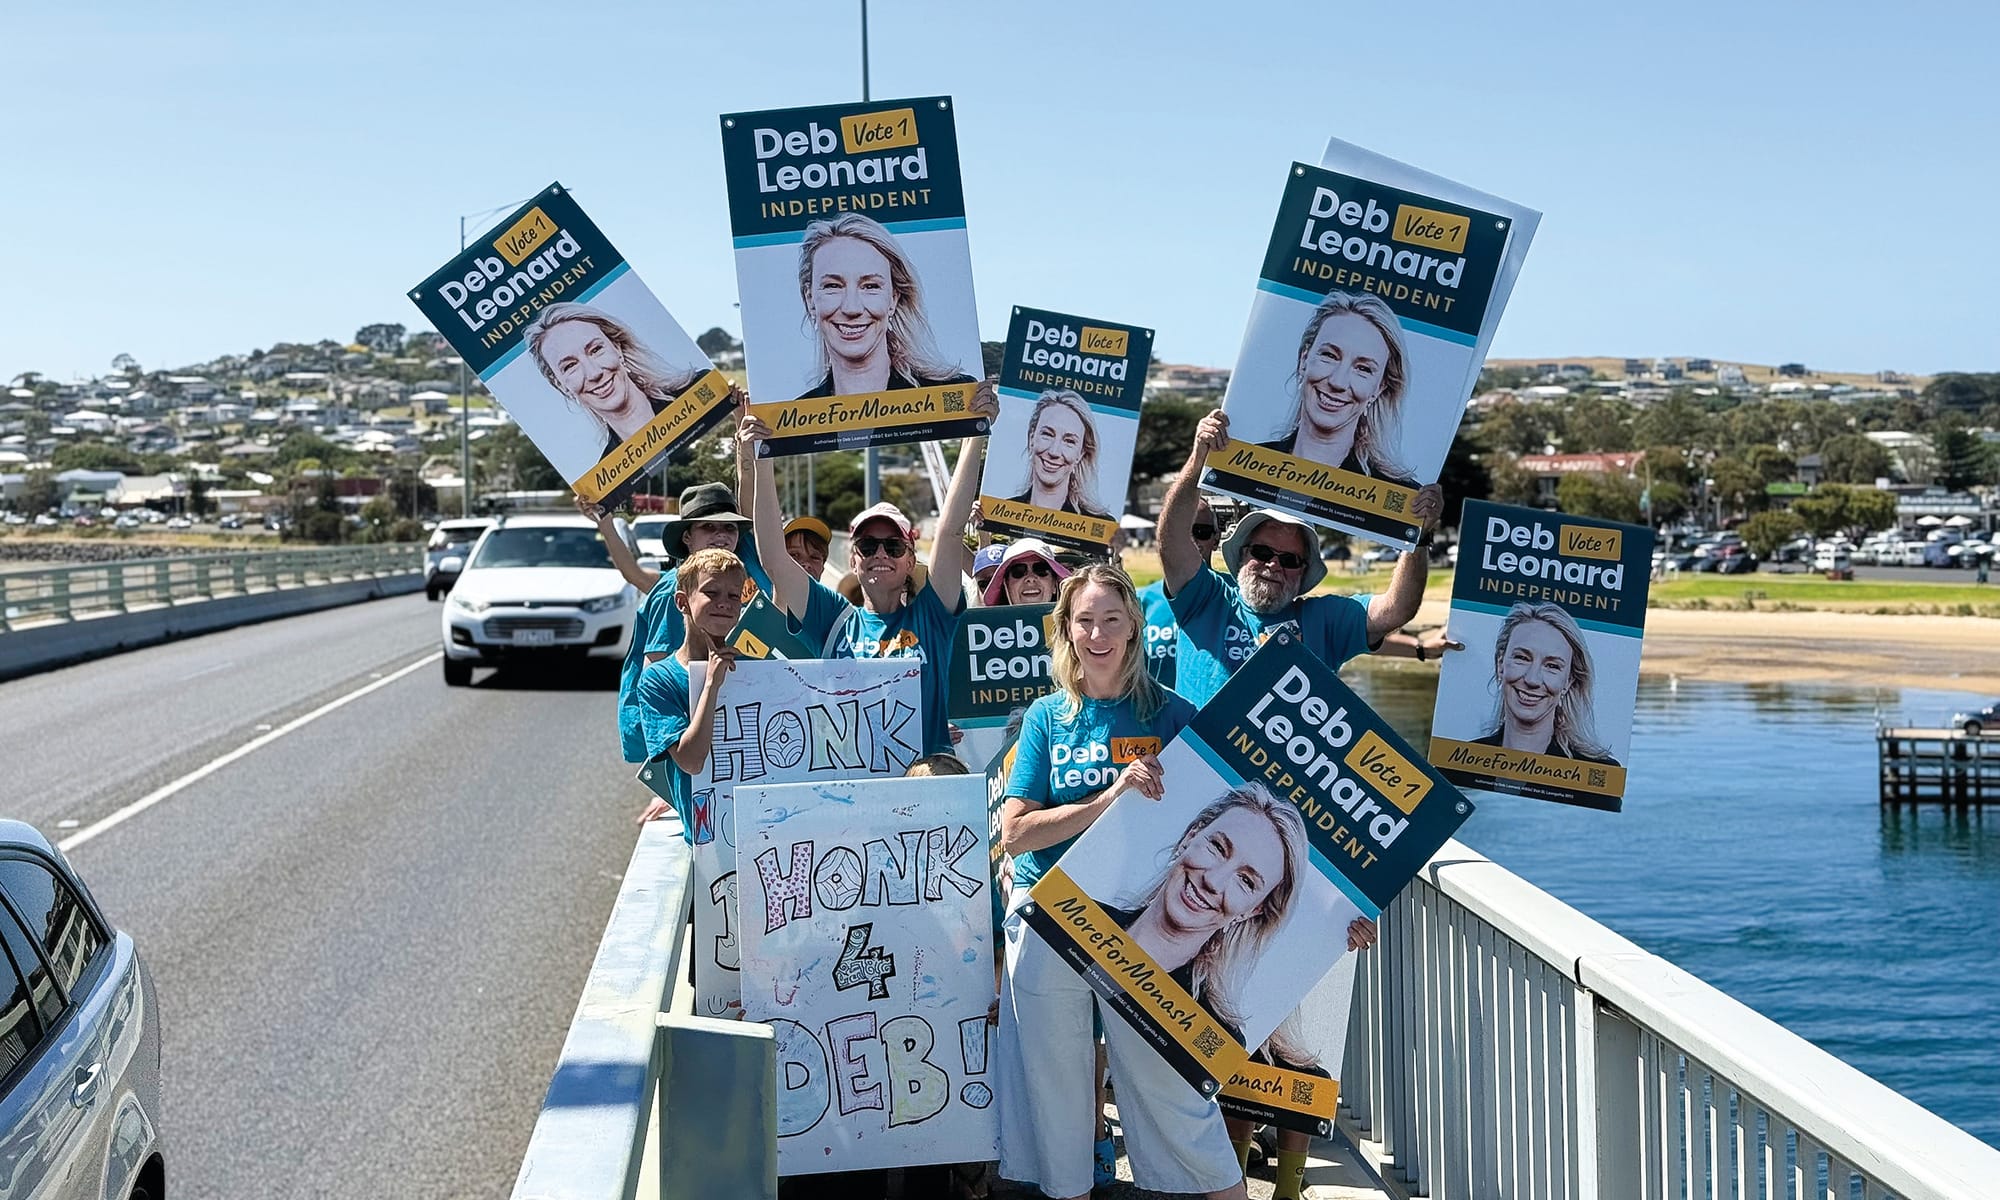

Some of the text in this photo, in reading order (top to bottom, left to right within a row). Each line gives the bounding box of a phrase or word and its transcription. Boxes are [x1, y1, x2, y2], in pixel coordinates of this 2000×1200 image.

[753, 122, 838, 159] Deb
[853, 118, 909, 146] Vote 1
[757, 147, 929, 193] Leonard
[761, 188, 933, 219] INDEPENDENT
[1309, 186, 1390, 234] Deb
[504, 214, 548, 257] Vote 1
[1404, 214, 1462, 243] Vote 1
[1300, 218, 1467, 289] Leonard
[438, 255, 505, 310] Deb
[457, 228, 582, 333] Leonard
[1292, 256, 1456, 314] INDEPENDENT
[480, 255, 595, 350] INDEPENDENT
[1026, 319, 1078, 349] Deb
[1087, 332, 1124, 350] Vote 1
[1018, 368, 1125, 399] INDEPENDENT
[1022, 342, 1129, 382] Leonard
[775, 393, 936, 430] MoreForMonash
[595, 401, 698, 492] MoreForMonash
[1228, 449, 1378, 504] MoreForMonash
[990, 503, 1087, 534] MoreForMonash
[1485, 516, 1555, 551] Deb
[1568, 531, 1617, 554] Vote 1
[1481, 543, 1625, 592] Leonard
[1479, 577, 1622, 612] INDEPENDENT
[967, 619, 1040, 652] Deb
[1272, 664, 1353, 748] Deb
[710, 699, 920, 783] HONK
[1052, 741, 1109, 766] Deb
[1119, 742, 1147, 759] Vote
[1053, 766, 1128, 789] Leon
[1246, 692, 1410, 850] Leonard
[1359, 744, 1422, 800] Vote 1
[1448, 746, 1581, 782] MoreForMonash
[988, 766, 1004, 809] Deb
[1225, 724, 1379, 870] INDEPENDENT
[753, 825, 984, 936] HONK
[832, 922, 897, 1001] 4
[1053, 896, 1199, 1034] MoreForMonash
[757, 1011, 994, 1139] DEB!
